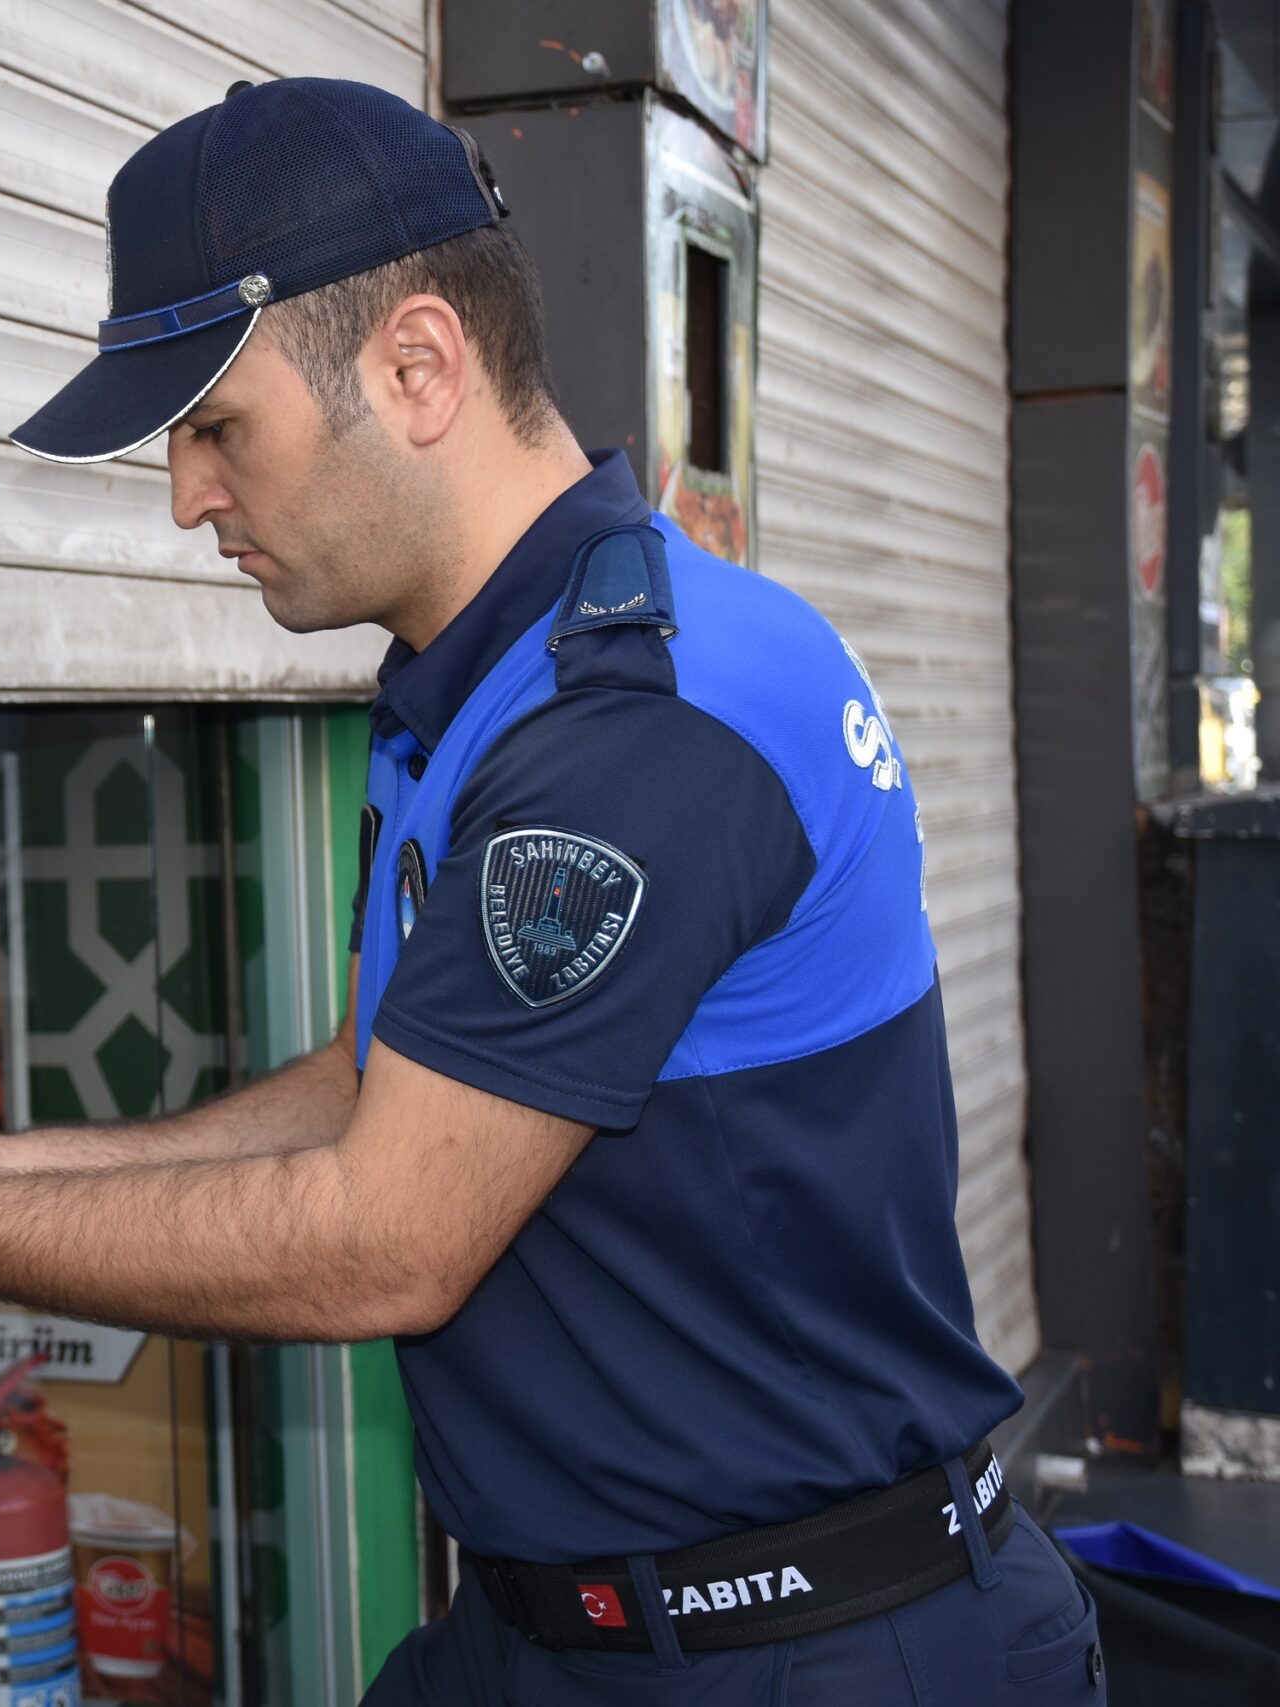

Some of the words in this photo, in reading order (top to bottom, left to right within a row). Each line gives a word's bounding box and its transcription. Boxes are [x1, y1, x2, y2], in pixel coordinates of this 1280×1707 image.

[510, 840, 622, 889] ŞAHİNBEY
[488, 884, 530, 980] BELEDİYE
[550, 912, 624, 989] ZABITASI
